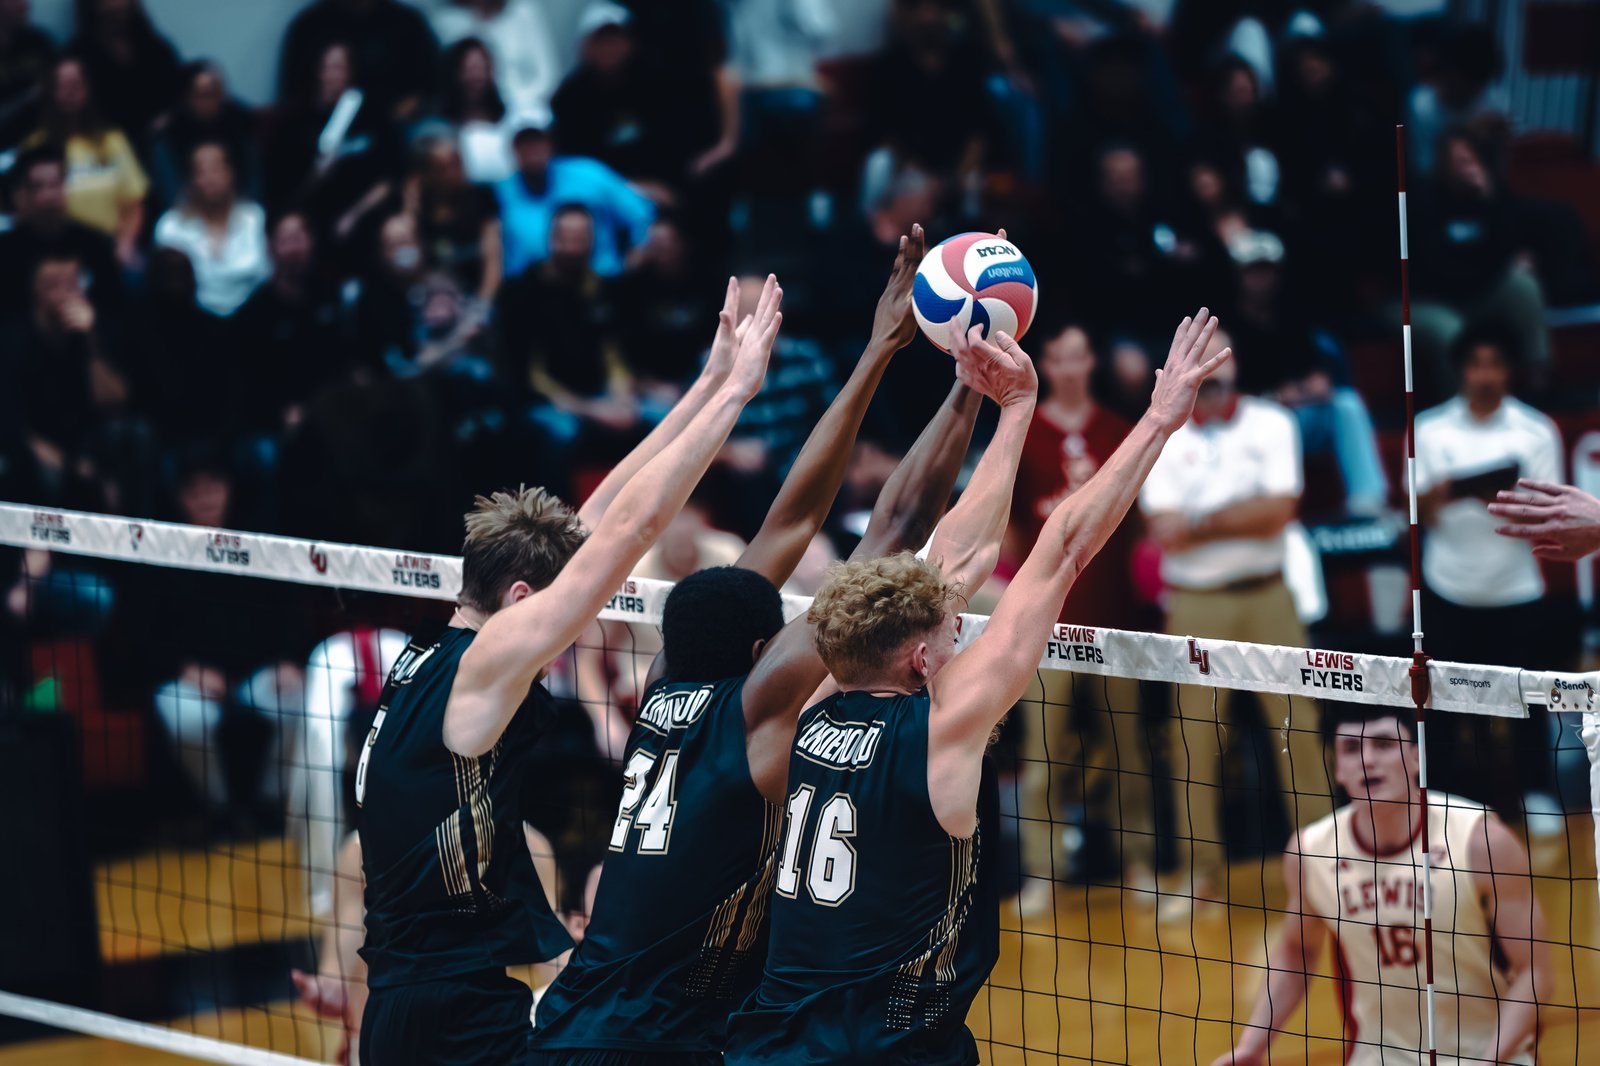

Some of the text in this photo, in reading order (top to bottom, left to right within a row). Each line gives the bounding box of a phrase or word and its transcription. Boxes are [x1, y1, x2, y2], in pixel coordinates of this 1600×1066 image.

[976, 245, 1017, 258] NCAA
[987, 266, 1024, 279] molten
[395, 554, 432, 571] LEWIS
[392, 570, 441, 589] FLYERS
[605, 595, 644, 613] YERS
[1053, 626, 1096, 643] LEWIS
[1047, 641, 1104, 663] FLYERS
[1305, 650, 1354, 670] LEWIS
[1300, 668, 1363, 692] FLYERS
[1561, 679, 1591, 690] Senoh
[608, 748, 681, 855] 24
[776, 783, 857, 907] 16
[1371, 923, 1421, 969] 16
